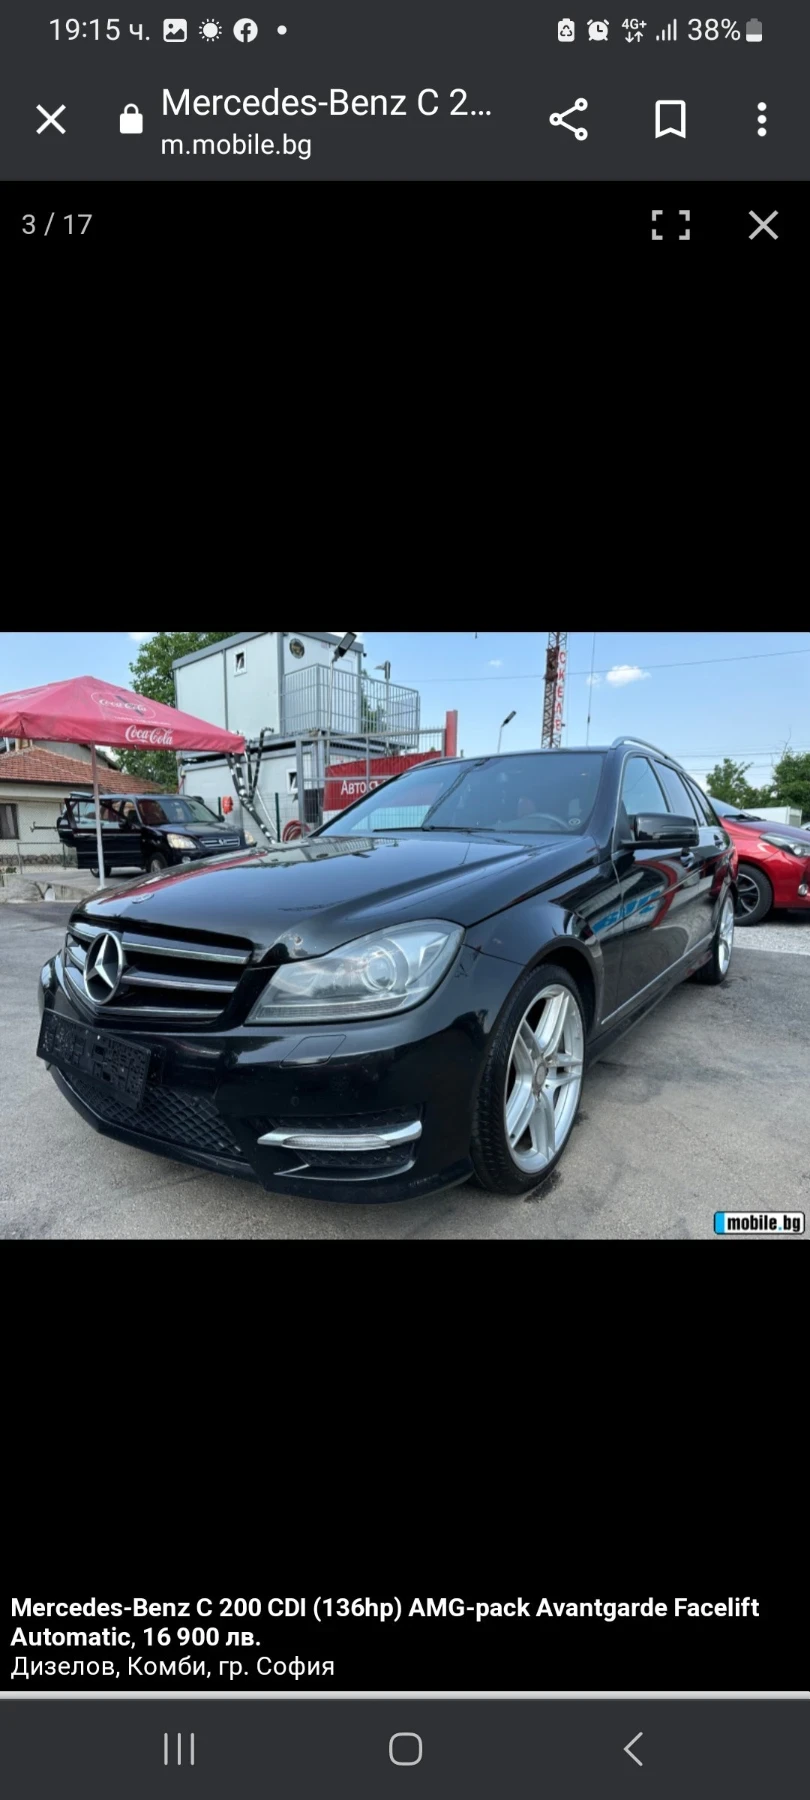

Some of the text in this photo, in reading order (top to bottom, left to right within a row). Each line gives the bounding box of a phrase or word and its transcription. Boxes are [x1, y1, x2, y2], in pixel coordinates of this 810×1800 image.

[49, 18, 150, 41] 19:15 ч.
[621, 18, 647, 30] 4G+
[687, 18, 741, 41] 38%
[162, 87, 407, 117] Mercedes-Benz
[417, 87, 439, 117] C
[161, 132, 312, 161] m.mobile.bg
[22, 212, 93, 237] 3 / 17
[124, 724, 174, 746] Coca-Cola
[11, 1596, 760, 1623] Mercedes-Benz C 200 CDI (136hp) AMG-pack Avantgarde Facelift
[10, 1626, 261, 1650] Automatic, 16 900 лв.
[10, 1655, 334, 1682] Дизелов, Комби, гр. София
